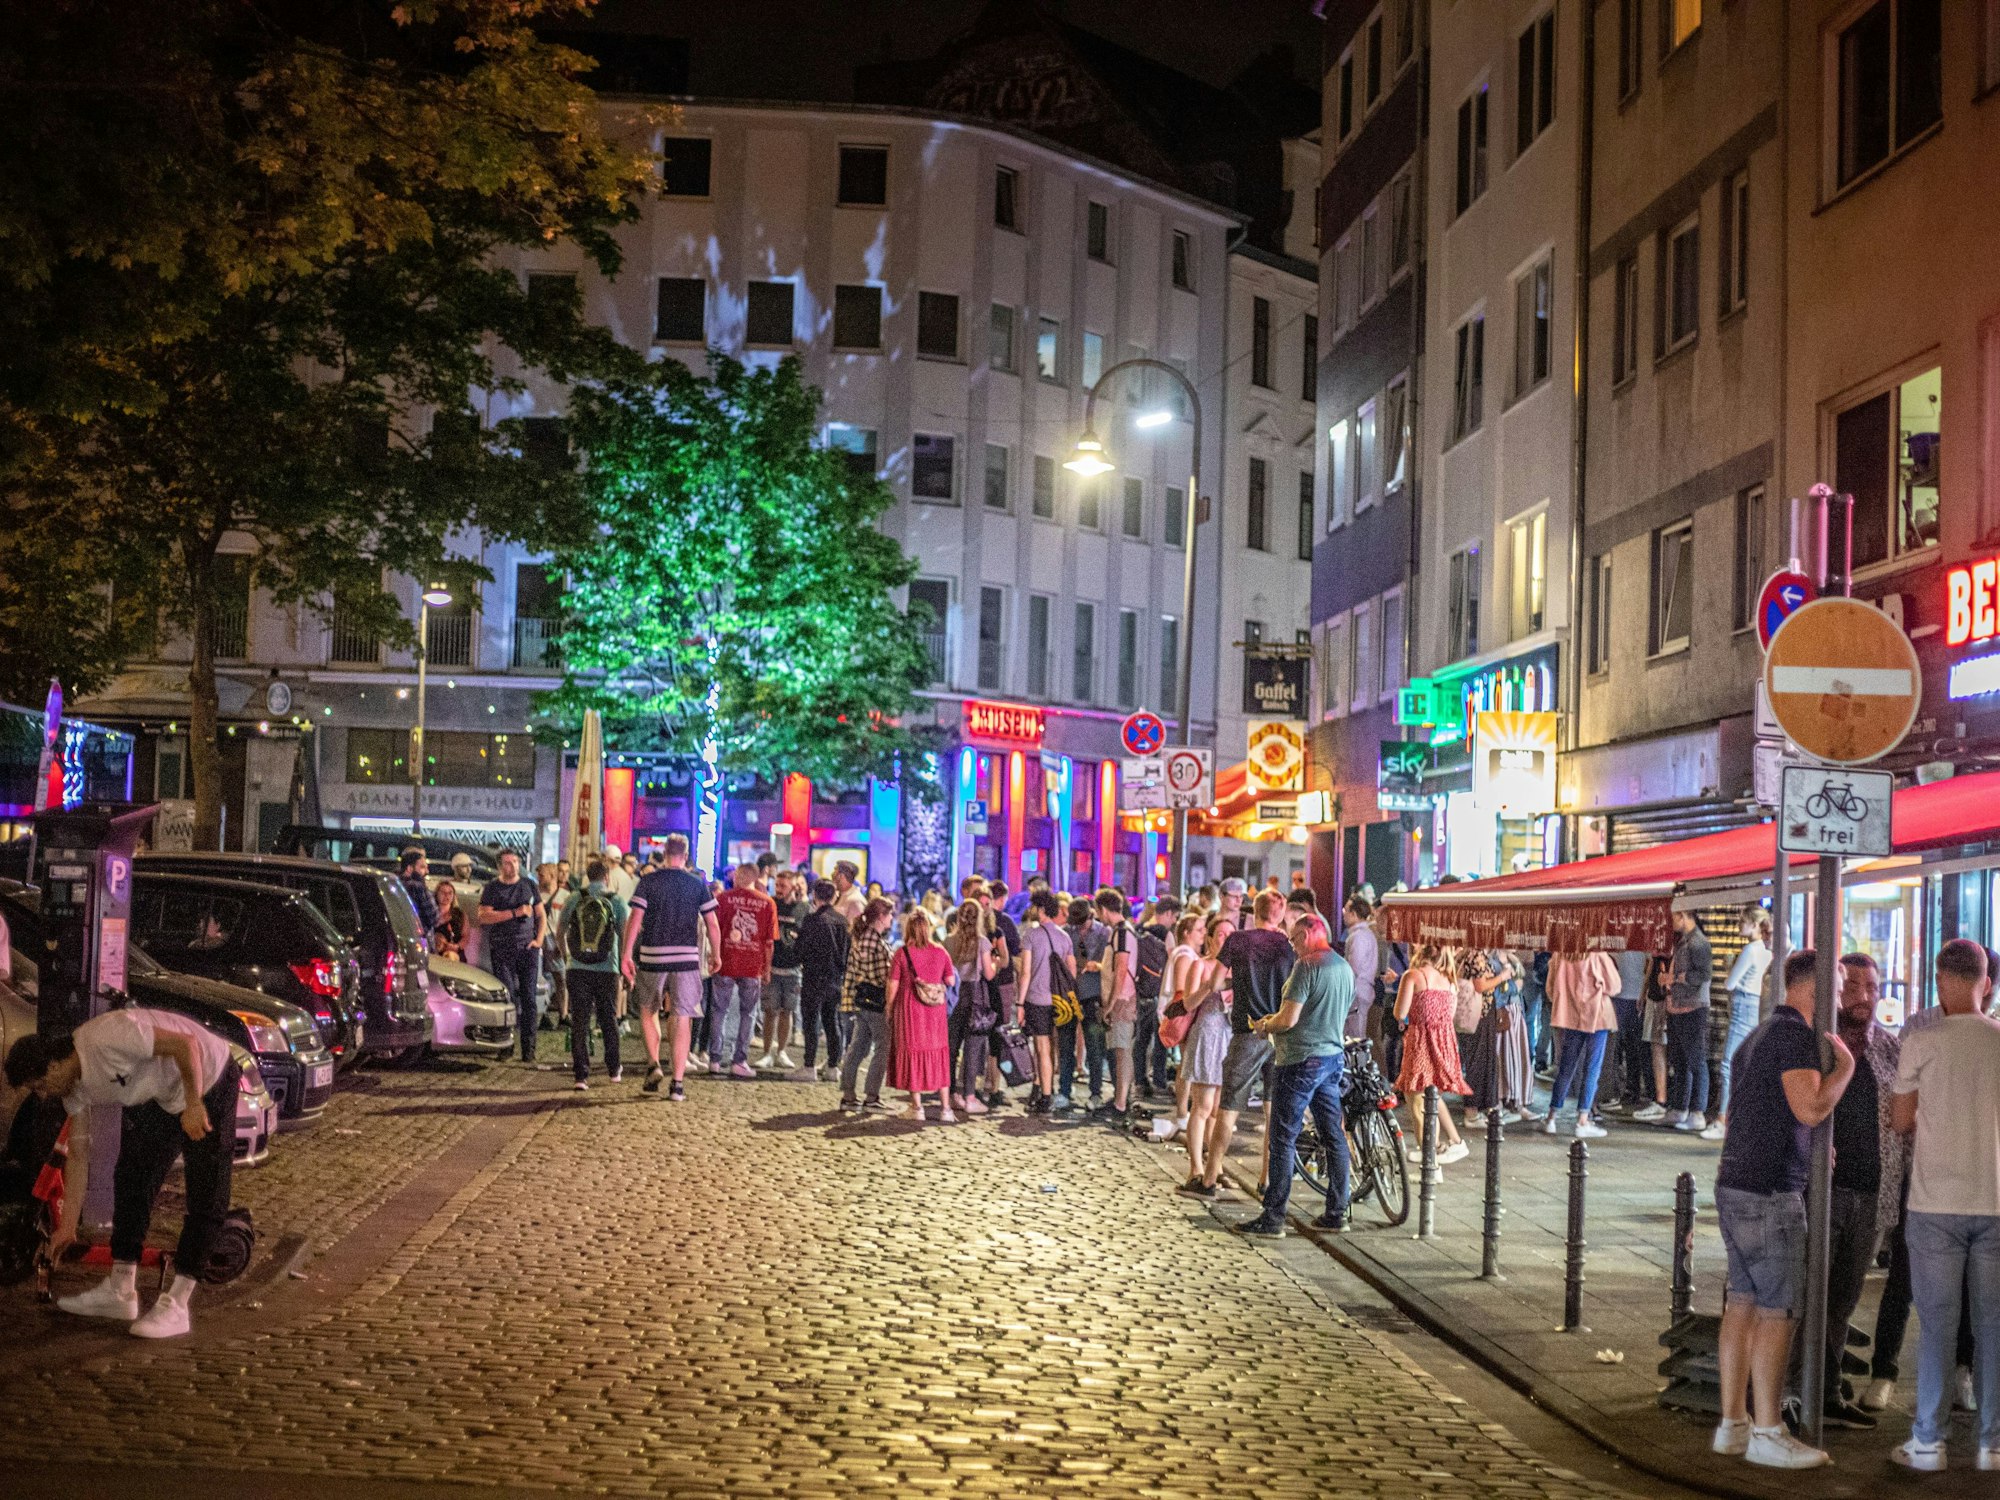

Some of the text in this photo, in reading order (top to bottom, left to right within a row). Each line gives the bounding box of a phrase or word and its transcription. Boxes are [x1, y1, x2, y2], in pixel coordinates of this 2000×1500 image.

[1949, 559, 2000, 646] BE
[1255, 682, 1297, 700] Gaffel
[1404, 694, 1426, 715] EC
[1174, 762, 1195, 781] 30
[1384, 751, 1427, 783] sky
[347, 792, 399, 808] ADAM
[486, 795, 534, 811] HAUS
[1819, 825, 1854, 845] frei
[111, 860, 126, 894] P
